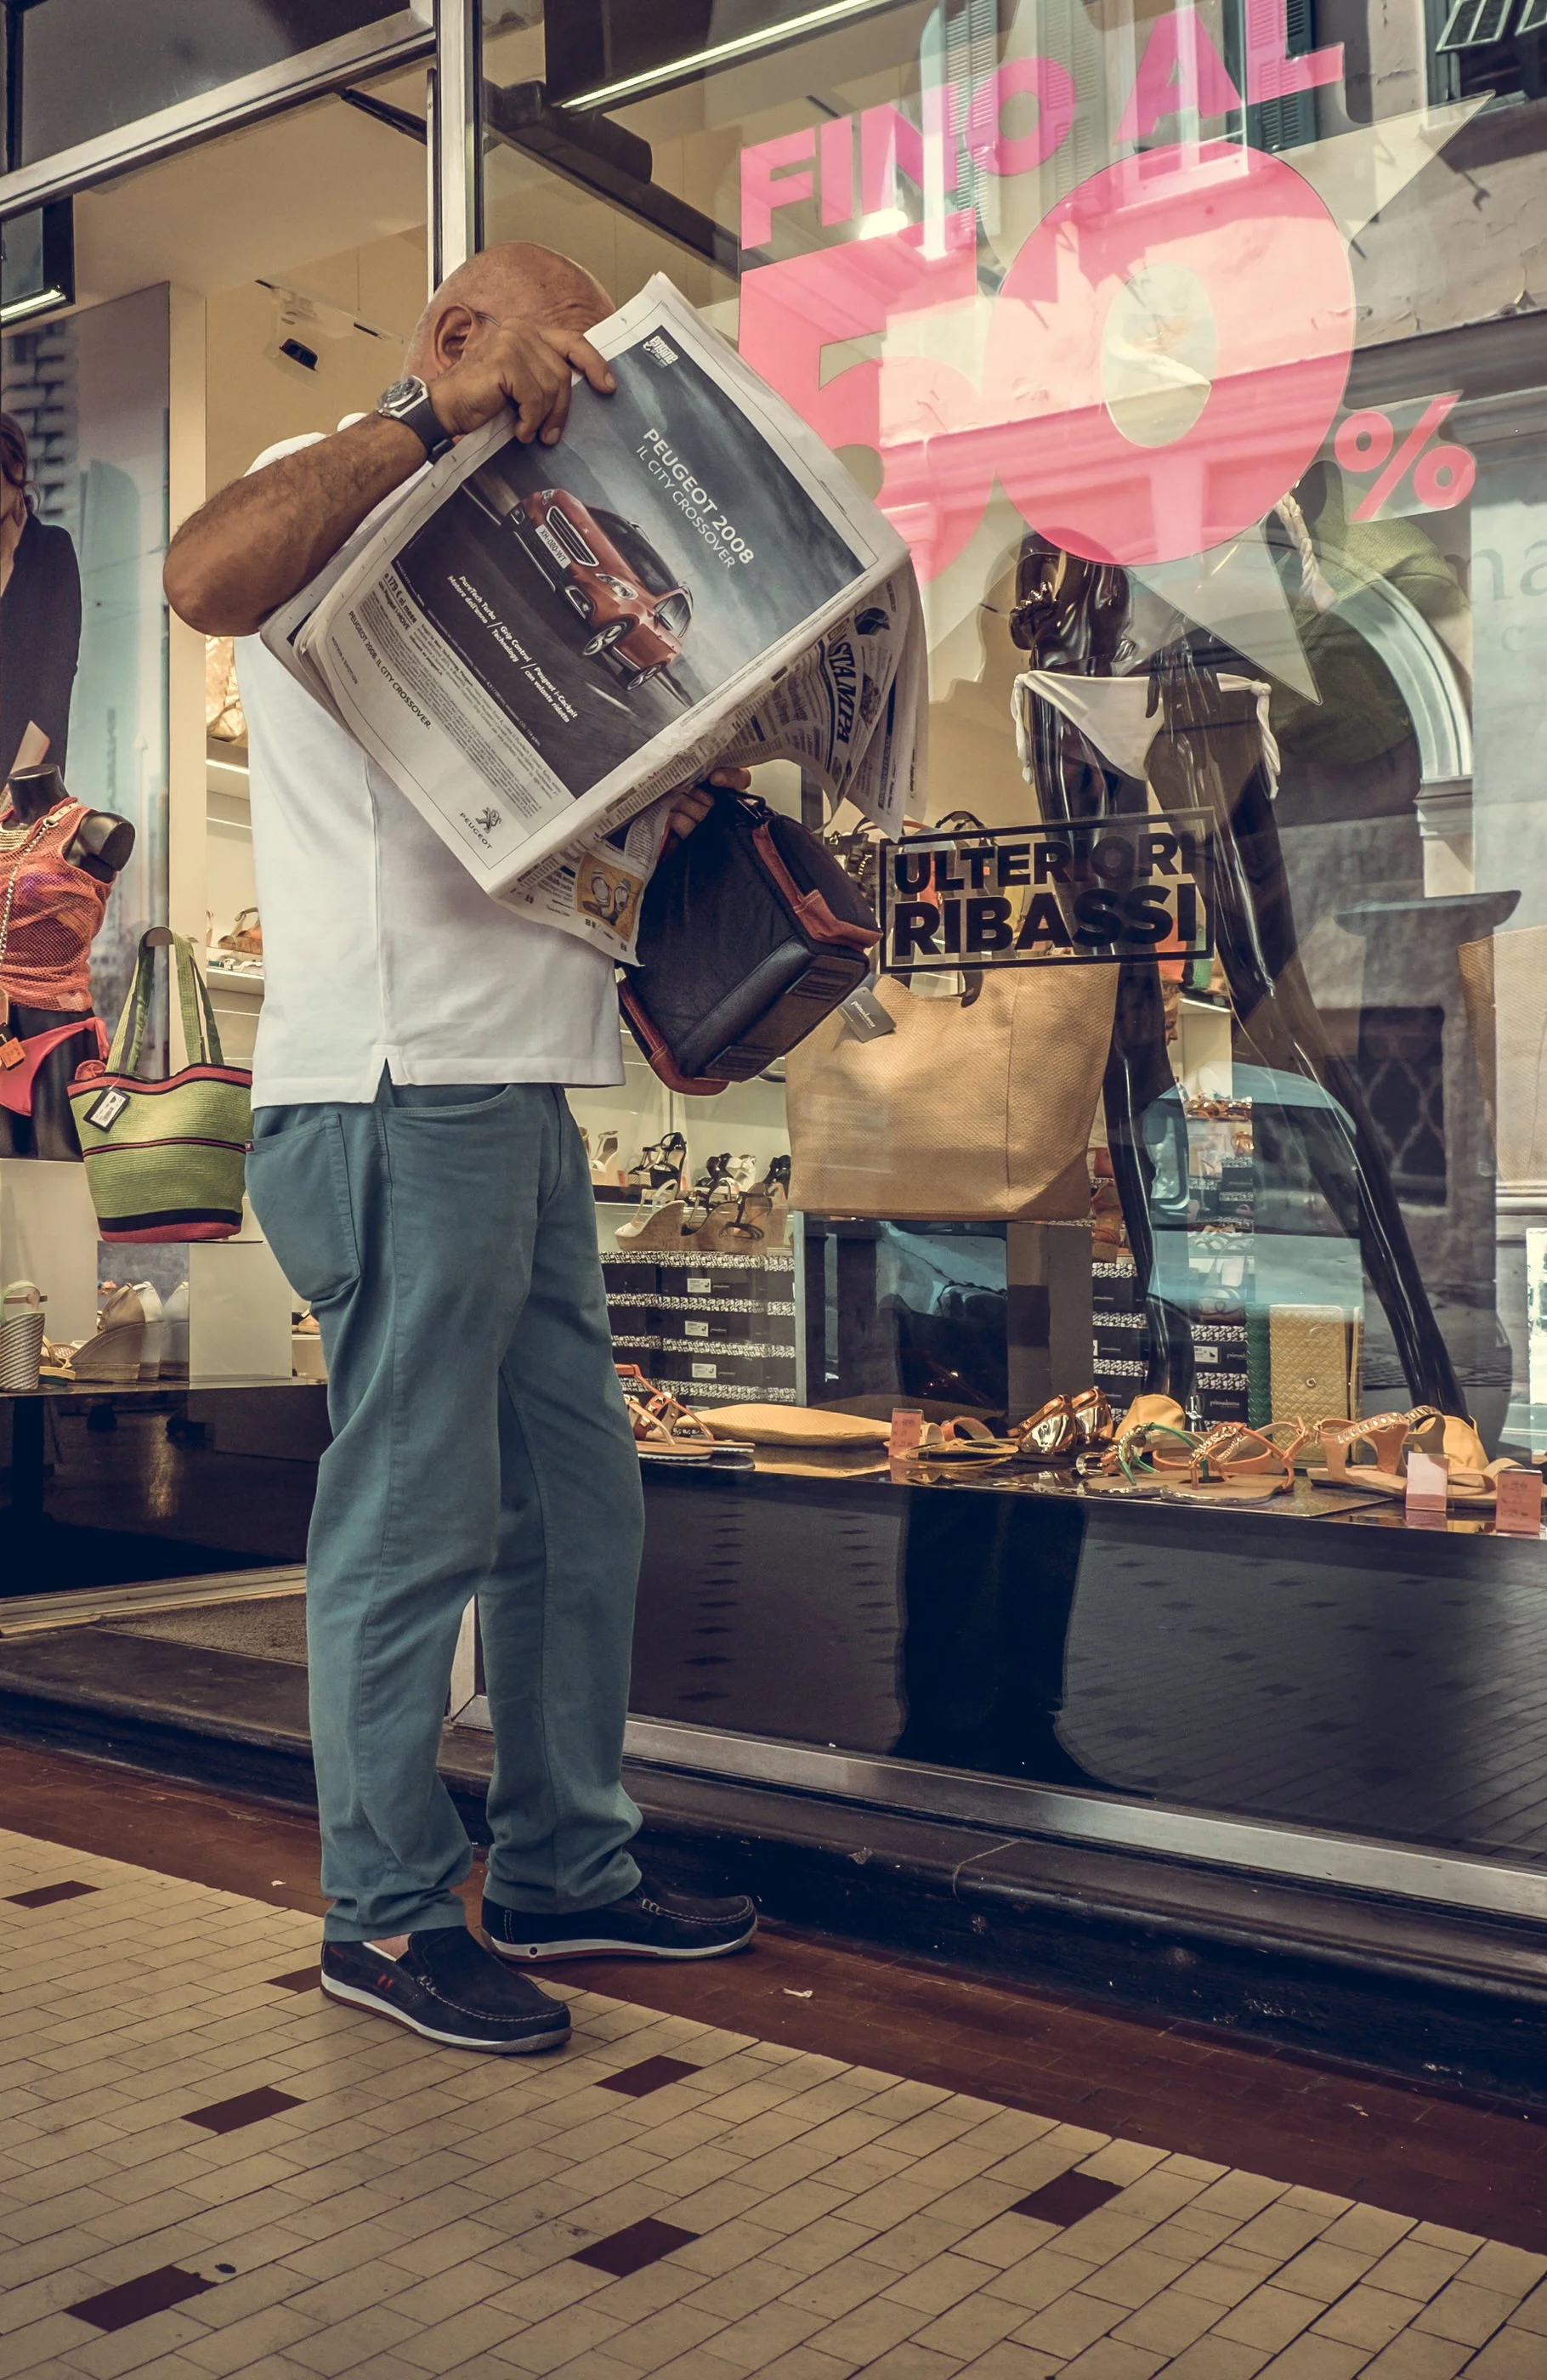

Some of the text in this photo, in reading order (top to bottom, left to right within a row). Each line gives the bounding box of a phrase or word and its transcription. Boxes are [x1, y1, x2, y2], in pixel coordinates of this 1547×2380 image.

[740, 0, 1344, 249] FINO AL
[635, 445, 735, 567] IL CITY CROSSOVER
[643, 430, 755, 564] PEUGEOT 2008
[386, 576, 399, 591] 179
[402, 604, 417, 622] mese
[447, 575, 467, 598] Motore
[459, 575, 496, 620] PureTech Turbo
[348, 611, 367, 641] PEUGEOT
[375, 659, 383, 667] IL
[379, 666, 395, 683] CITY
[392, 683, 432, 728] CROSSOVER.
[490, 629, 519, 663] Technology
[498, 625, 531, 662] Grip Control
[524, 669, 570, 722] con volante ridotto
[532, 666, 555, 693] Peugeot
[827, 639, 857, 745] STAMPA
[460, 813, 491, 848] PEUGEOT
[894, 831, 1196, 895] ULTERIORI
[894, 883, 1196, 957] RIBASSI
